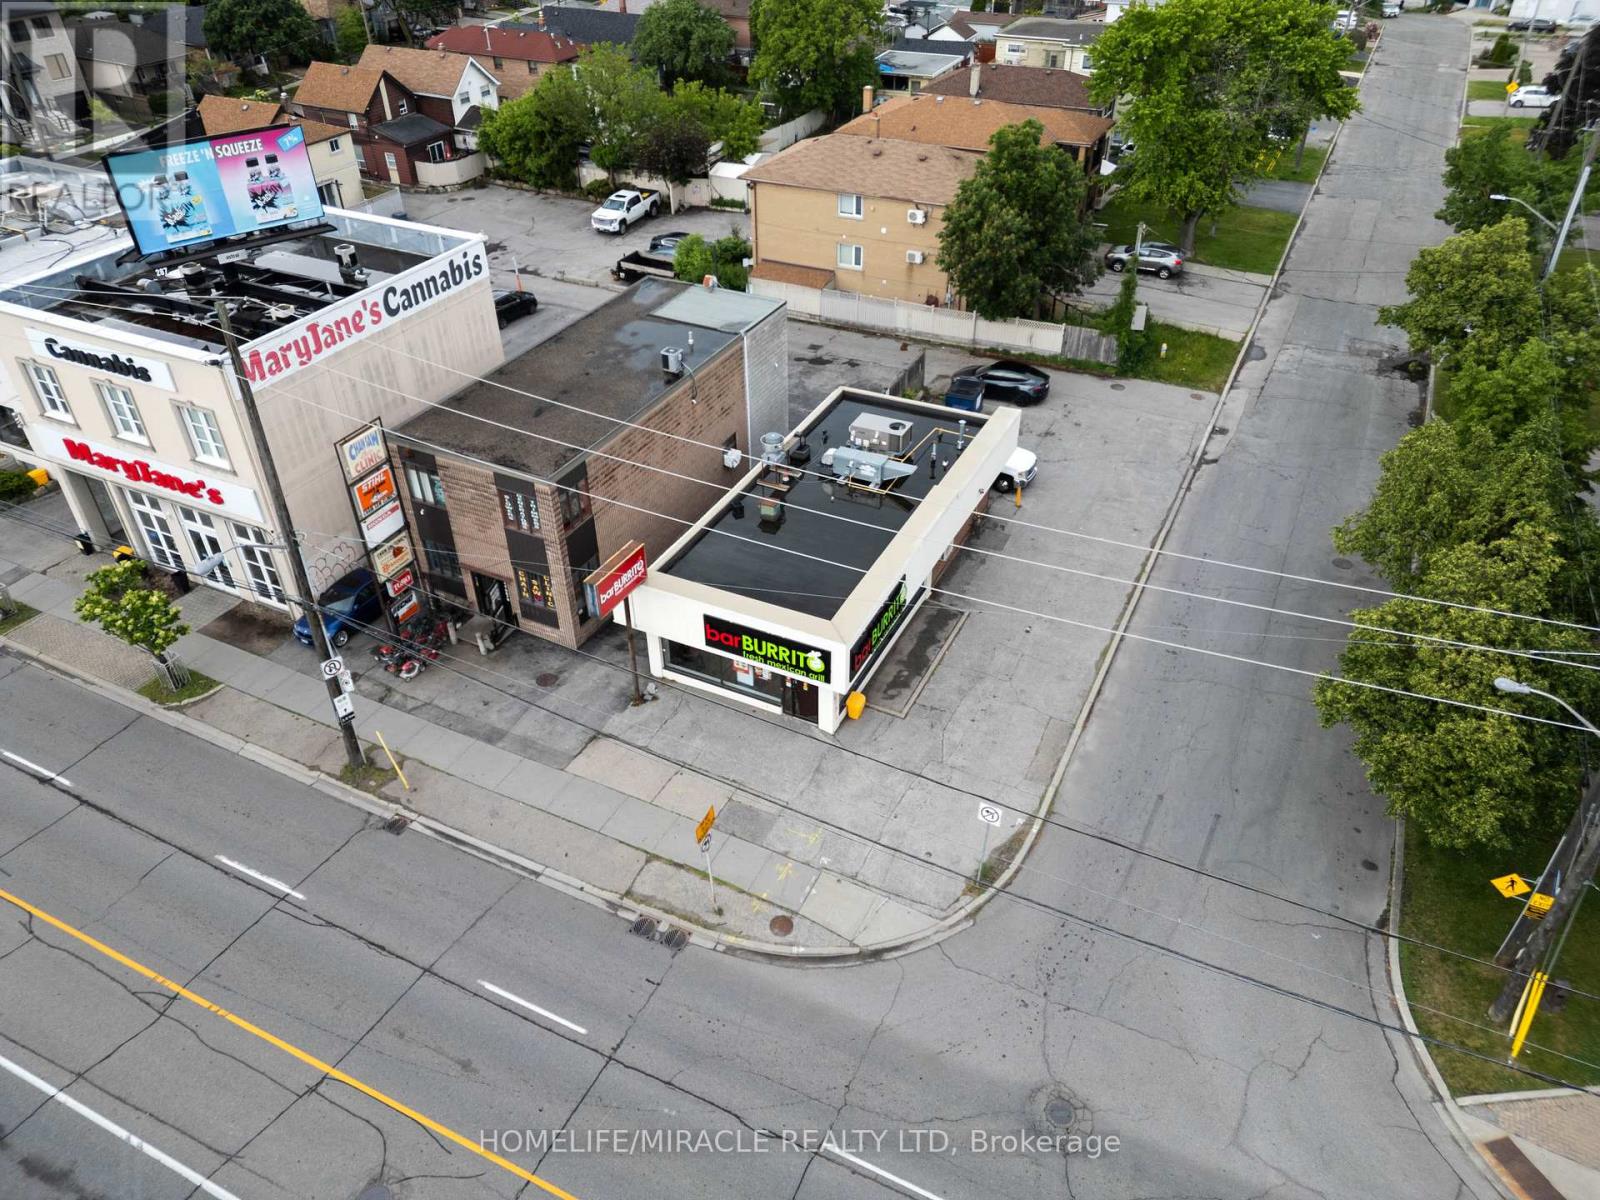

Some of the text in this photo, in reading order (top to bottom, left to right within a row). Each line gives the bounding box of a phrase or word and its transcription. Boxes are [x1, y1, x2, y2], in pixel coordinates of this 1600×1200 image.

[159, 150, 200, 168] FREEZE
[215, 139, 263, 158] SQUEEZE
[241, 251, 483, 384] MaryJane's Cannabis
[45, 338, 152, 382] Cannabis
[63, 438, 225, 505] MaryJane's
[743, 650, 764, 663] fresh
[767, 659, 807, 676] mexican
